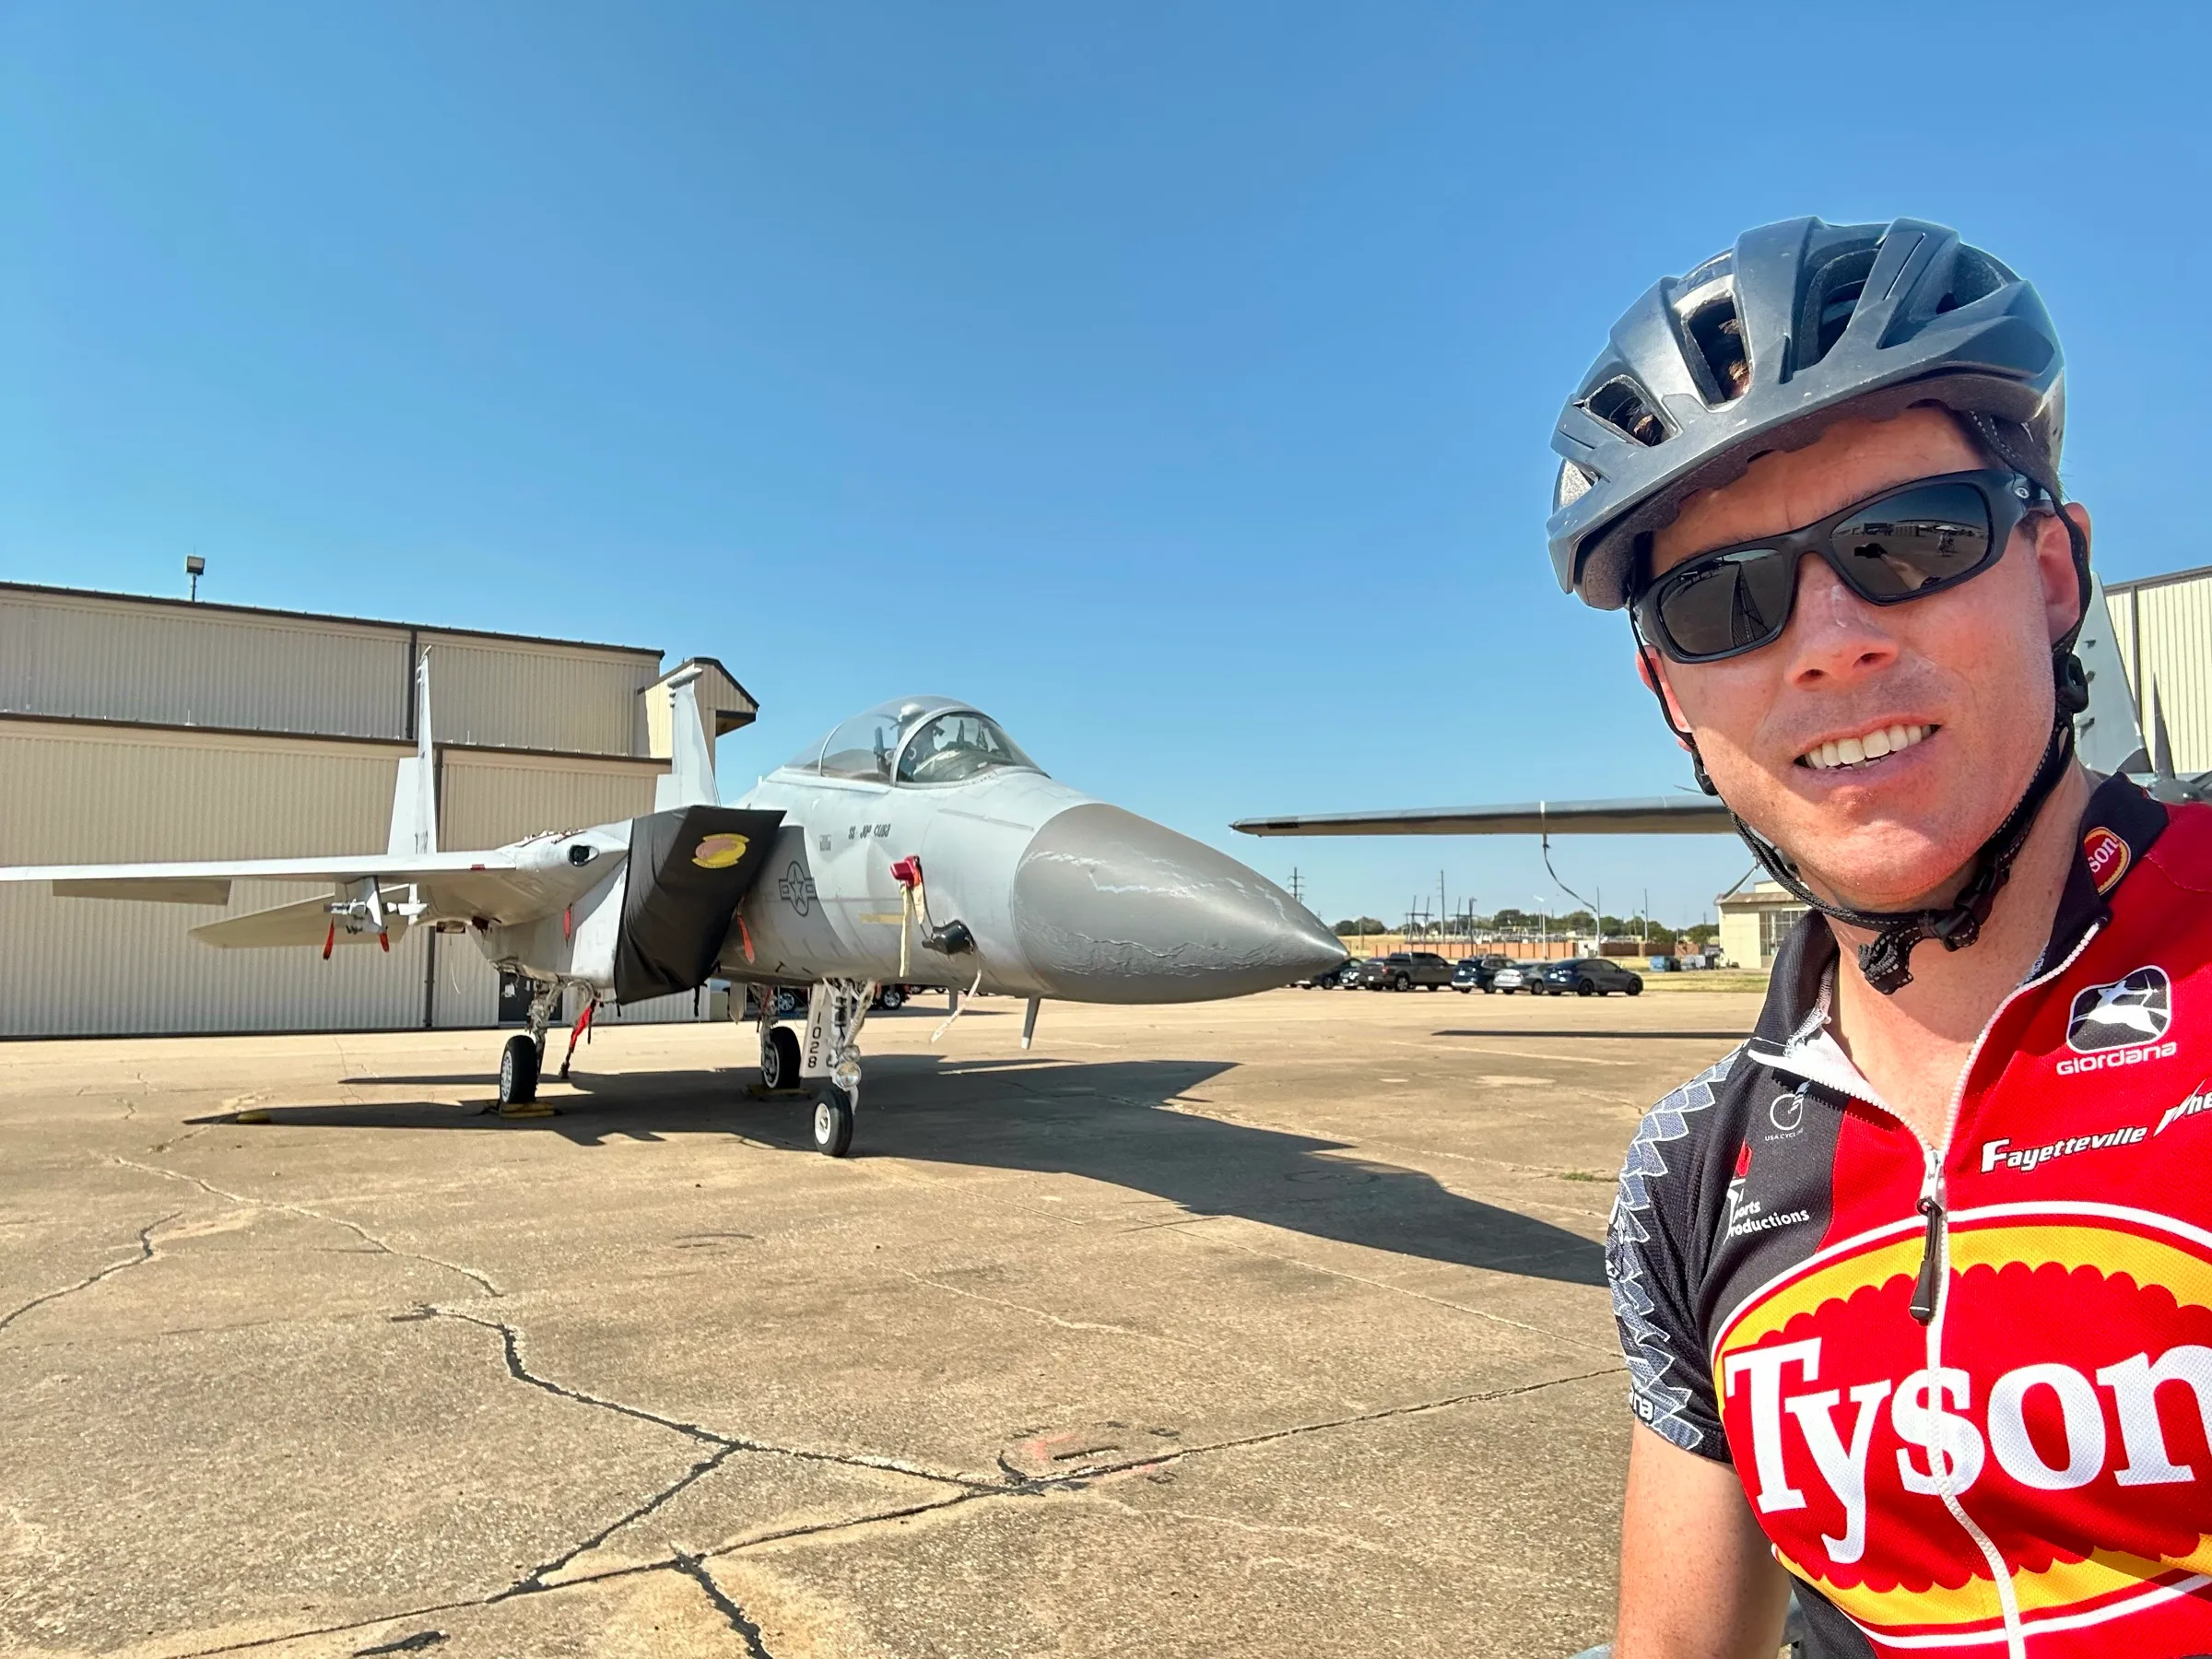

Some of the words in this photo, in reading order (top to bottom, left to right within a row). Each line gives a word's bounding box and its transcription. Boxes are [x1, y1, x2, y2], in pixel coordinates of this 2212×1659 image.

[808, 1011, 821, 1068] 1028
[2056, 1041, 2177, 1076] Giordana
[1982, 1126, 2147, 1173] Fayetteville
[1724, 1336, 2212, 1564] Tyson
